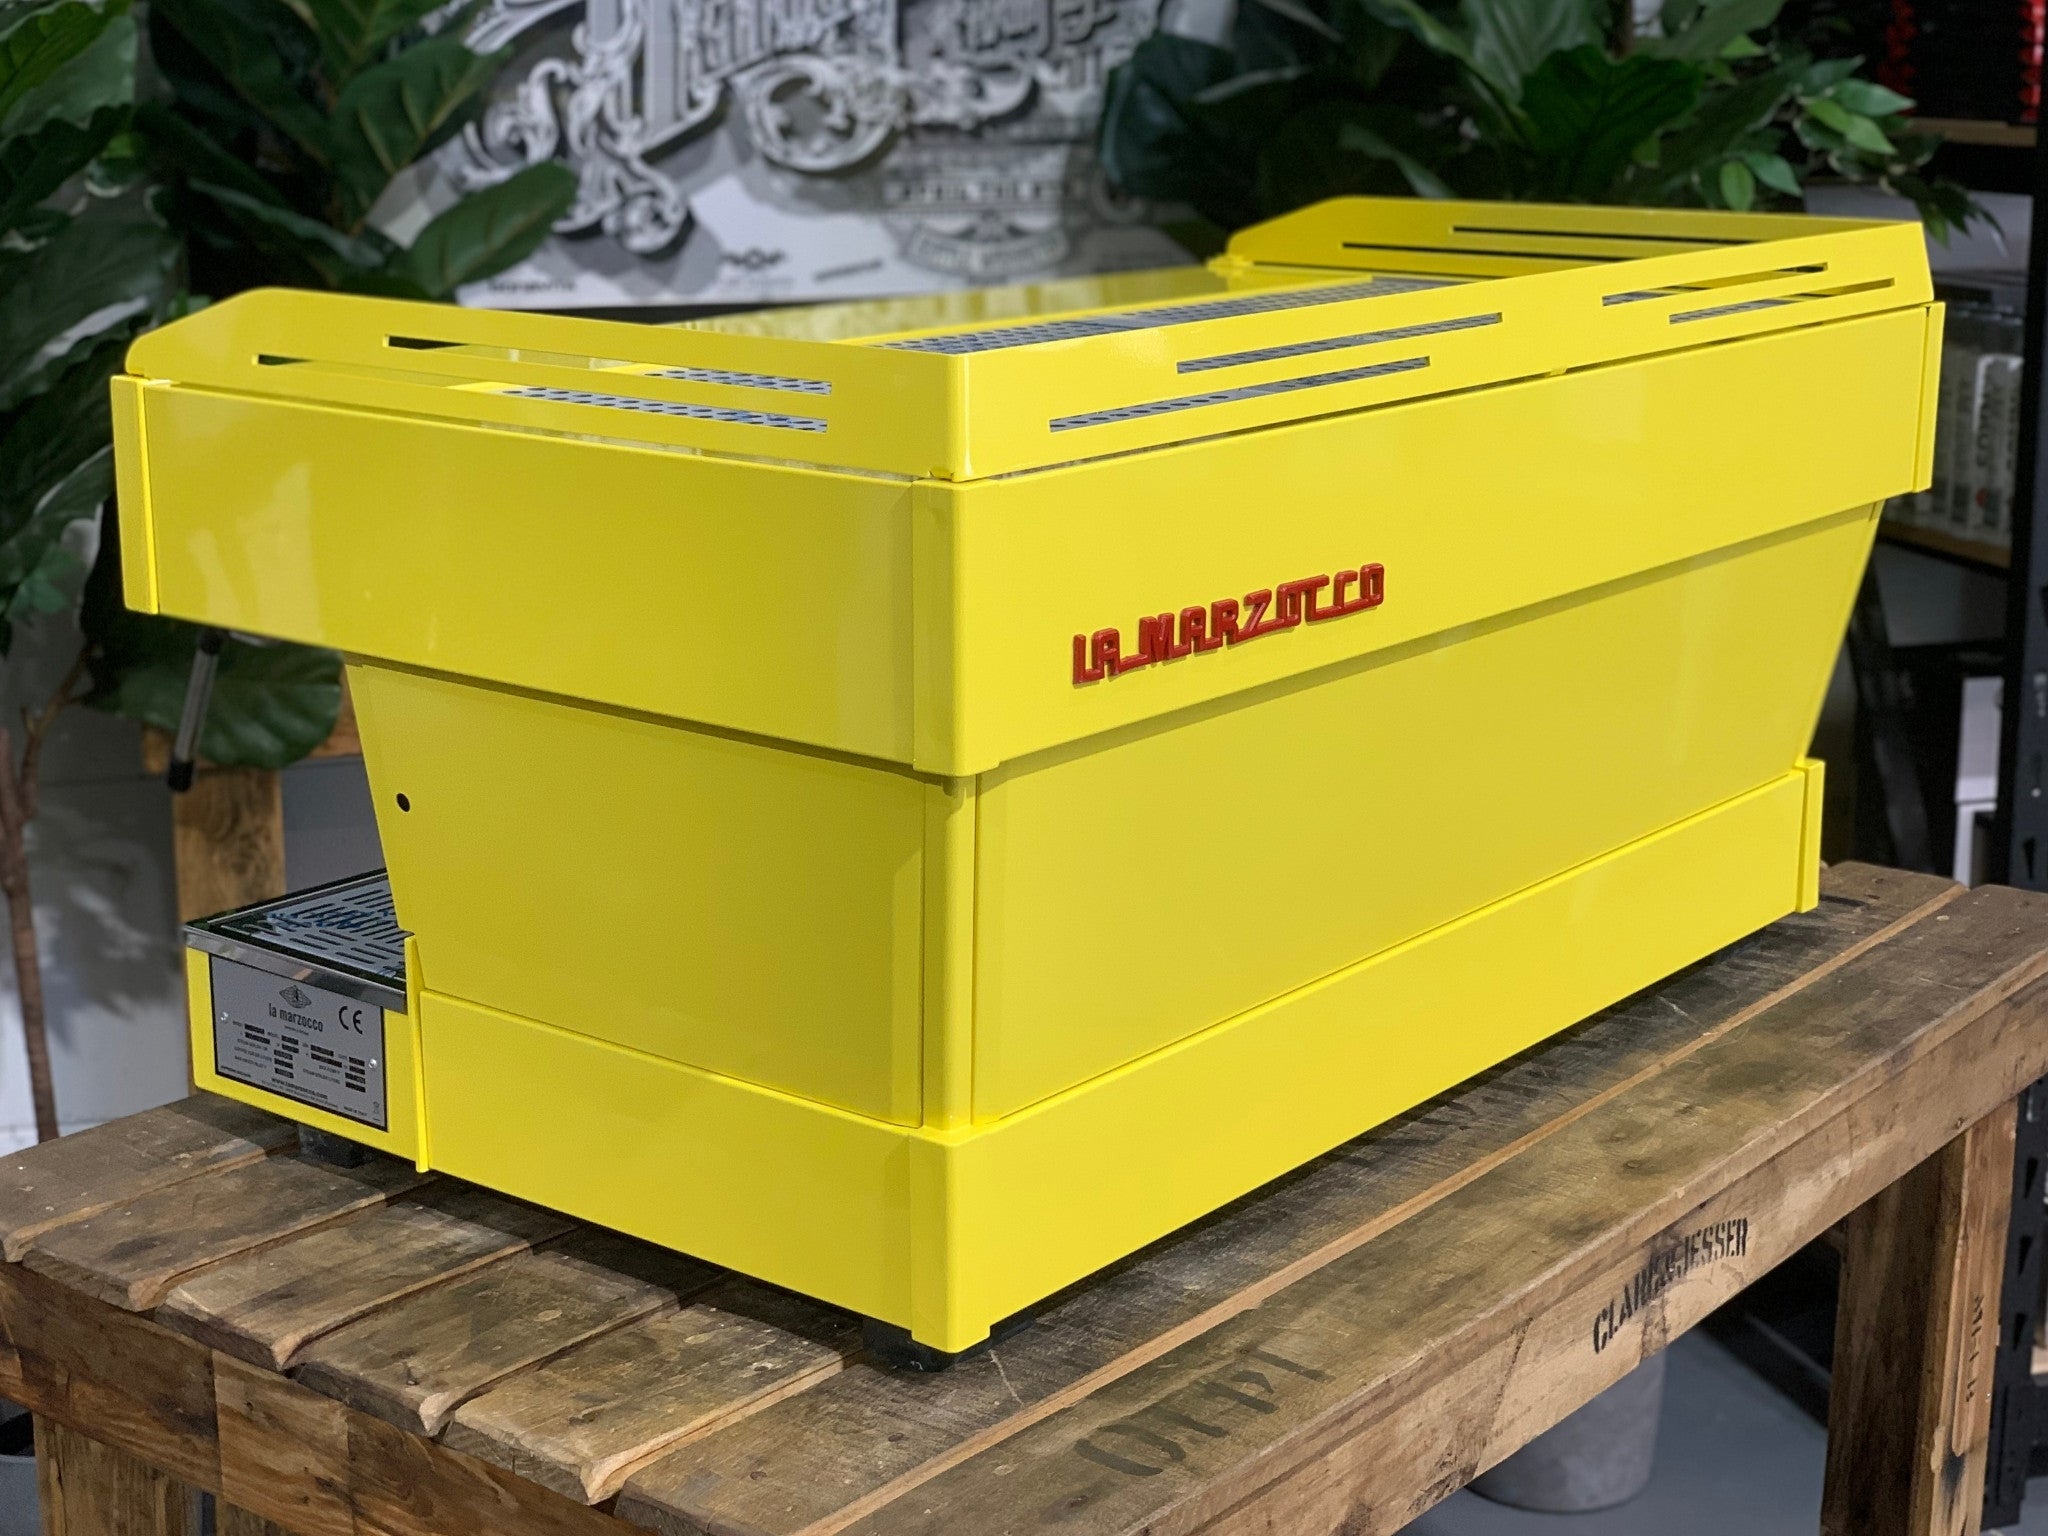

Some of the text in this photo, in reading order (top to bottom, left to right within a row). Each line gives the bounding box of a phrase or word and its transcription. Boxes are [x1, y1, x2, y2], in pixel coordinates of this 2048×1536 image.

[1072, 628, 1130, 686] LA
[278, 1008, 324, 1033] marzocco
[338, 1005, 363, 1035] CE
